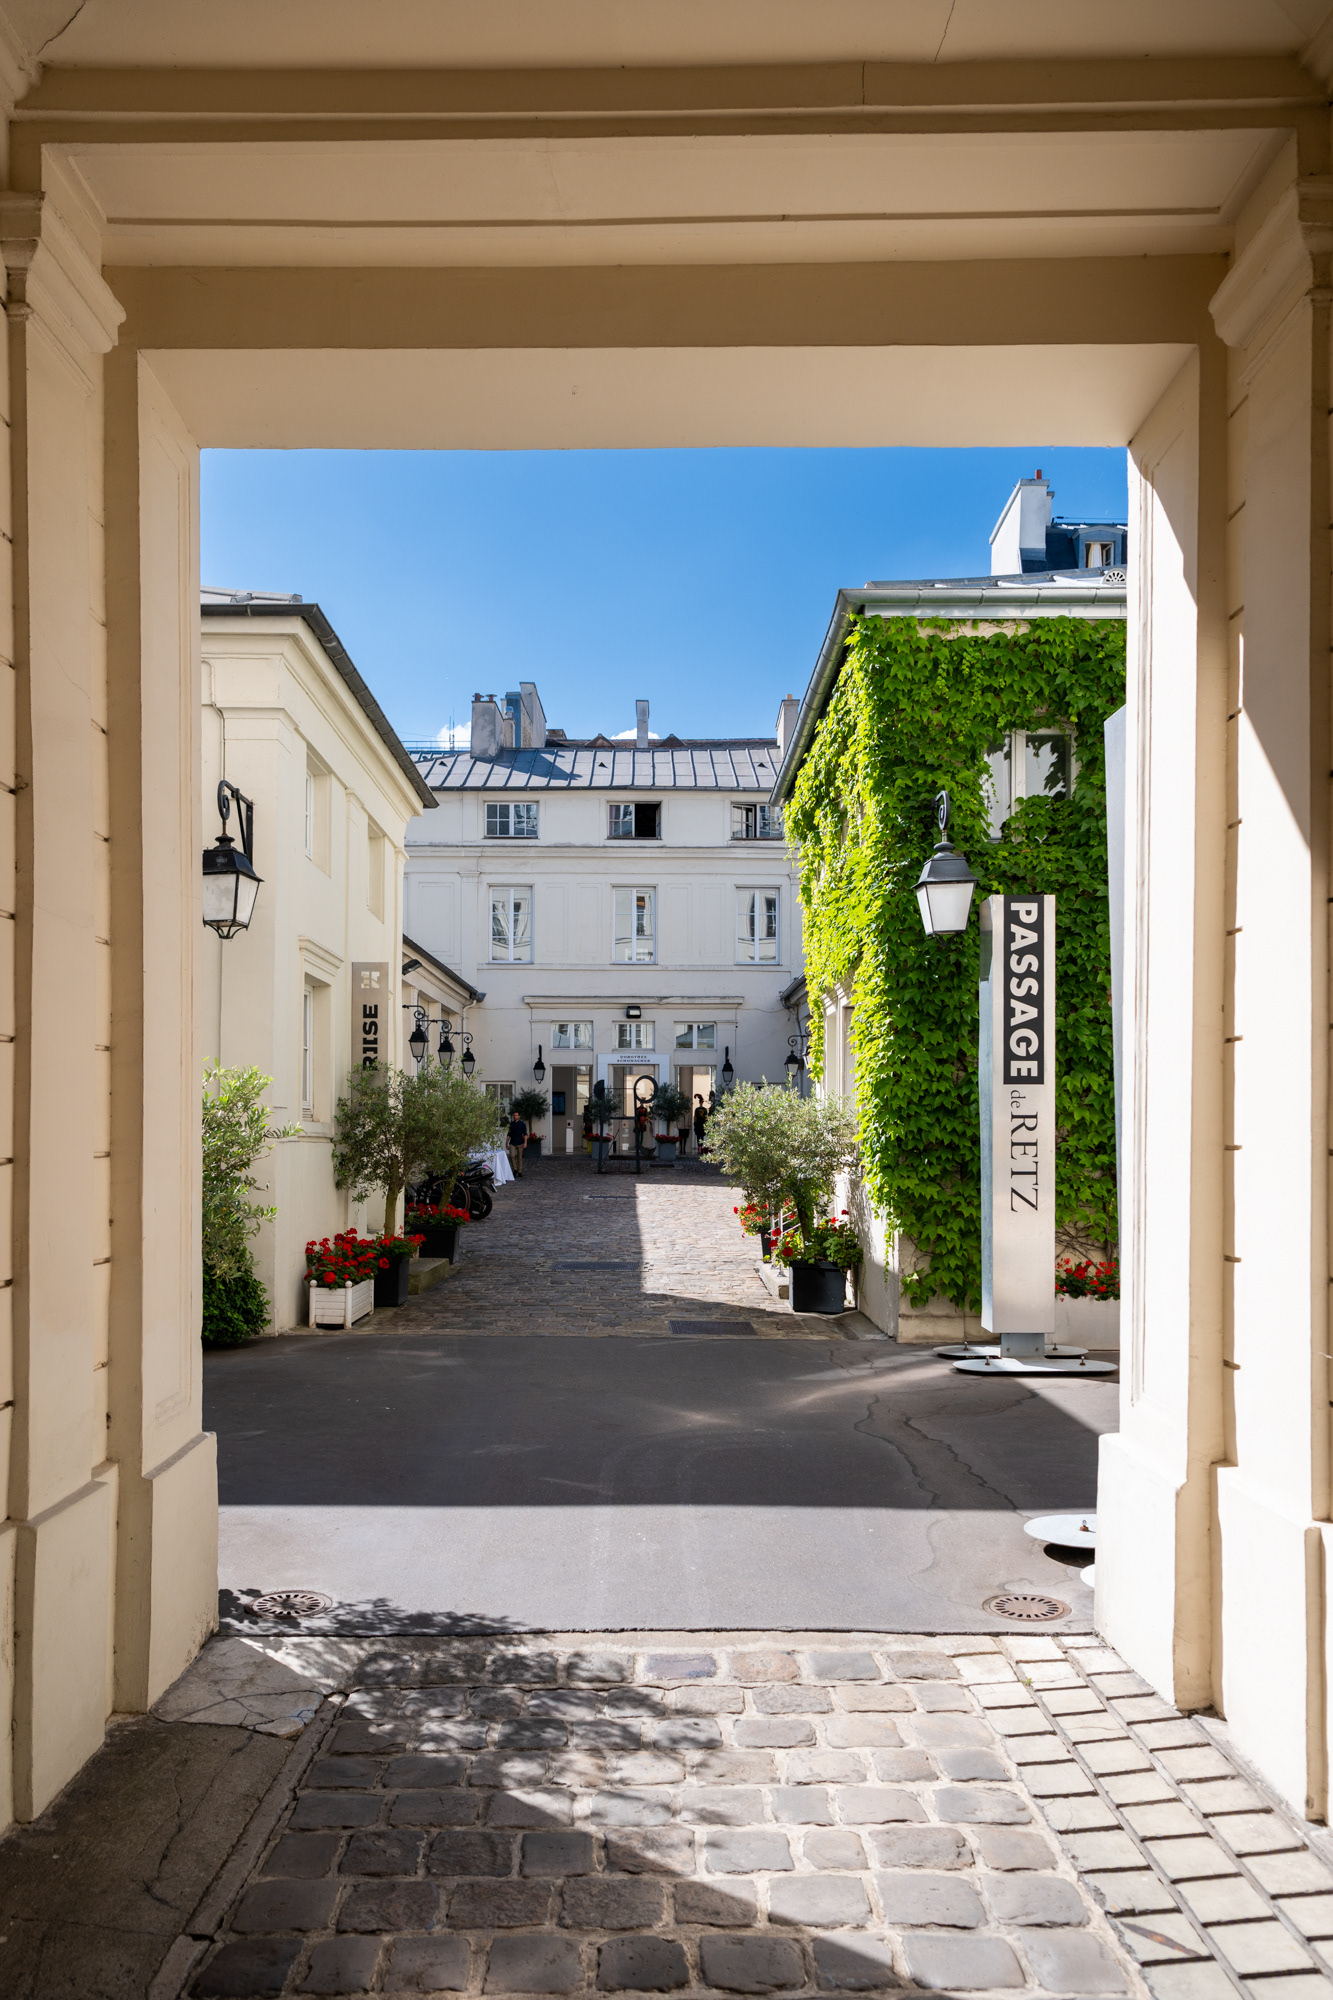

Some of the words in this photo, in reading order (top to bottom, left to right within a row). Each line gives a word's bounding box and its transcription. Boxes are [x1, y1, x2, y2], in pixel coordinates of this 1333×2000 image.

[1009, 902, 1039, 1077] PASSAGE
[1010, 1089, 1026, 1109] de
[1010, 1111, 1039, 1213] RETZ
